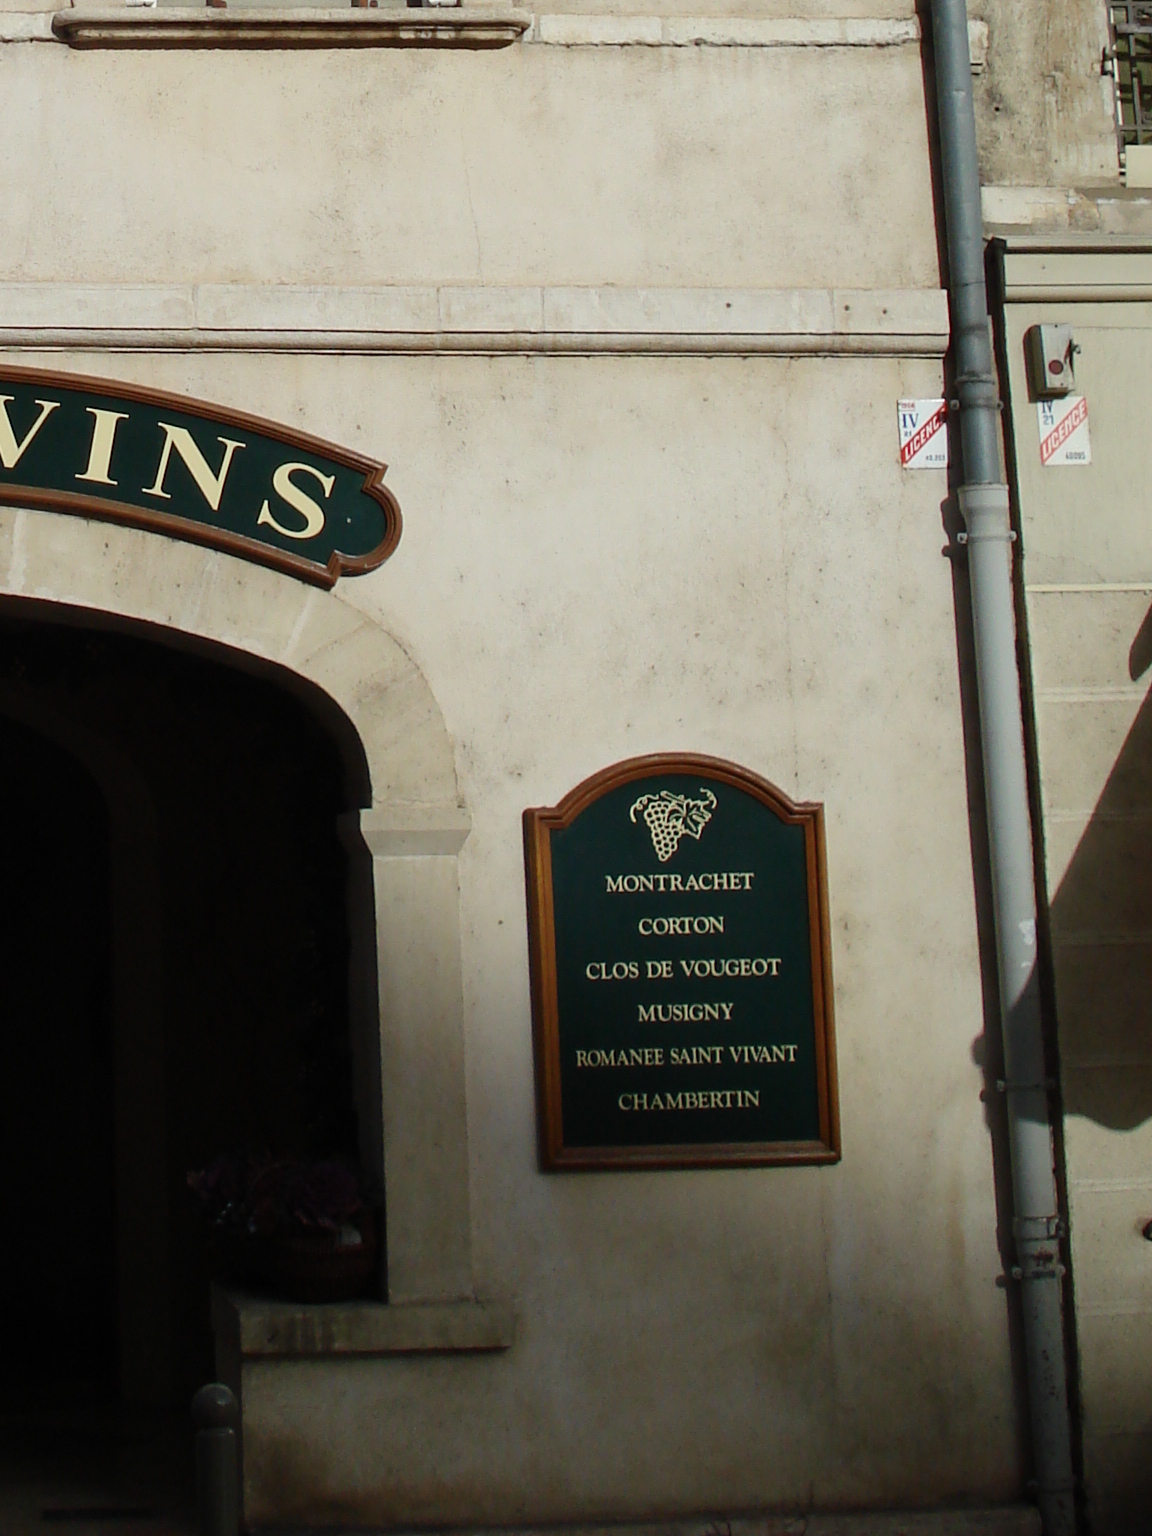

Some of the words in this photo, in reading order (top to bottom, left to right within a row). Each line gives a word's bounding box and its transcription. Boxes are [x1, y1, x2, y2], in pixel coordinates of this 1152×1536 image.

[902, 413, 919, 429] IV
[1042, 399, 1087, 461] LICENCE
[1043, 414, 1055, 425] 21
[905, 407, 946, 461] LICENC
[605, 872, 755, 893] MONTRACHET
[638, 916, 725, 936] CORTON
[585, 961, 640, 980] CLOS
[646, 960, 674, 979] DE
[679, 958, 782, 977] VOUGEOT
[637, 1002, 734, 1023] MUSIGNY
[575, 1048, 665, 1067] ROMANEE
[670, 1046, 724, 1065] SAINT
[728, 1044, 799, 1063] VIVANT
[618, 1090, 761, 1111] CHAMBERTIN
